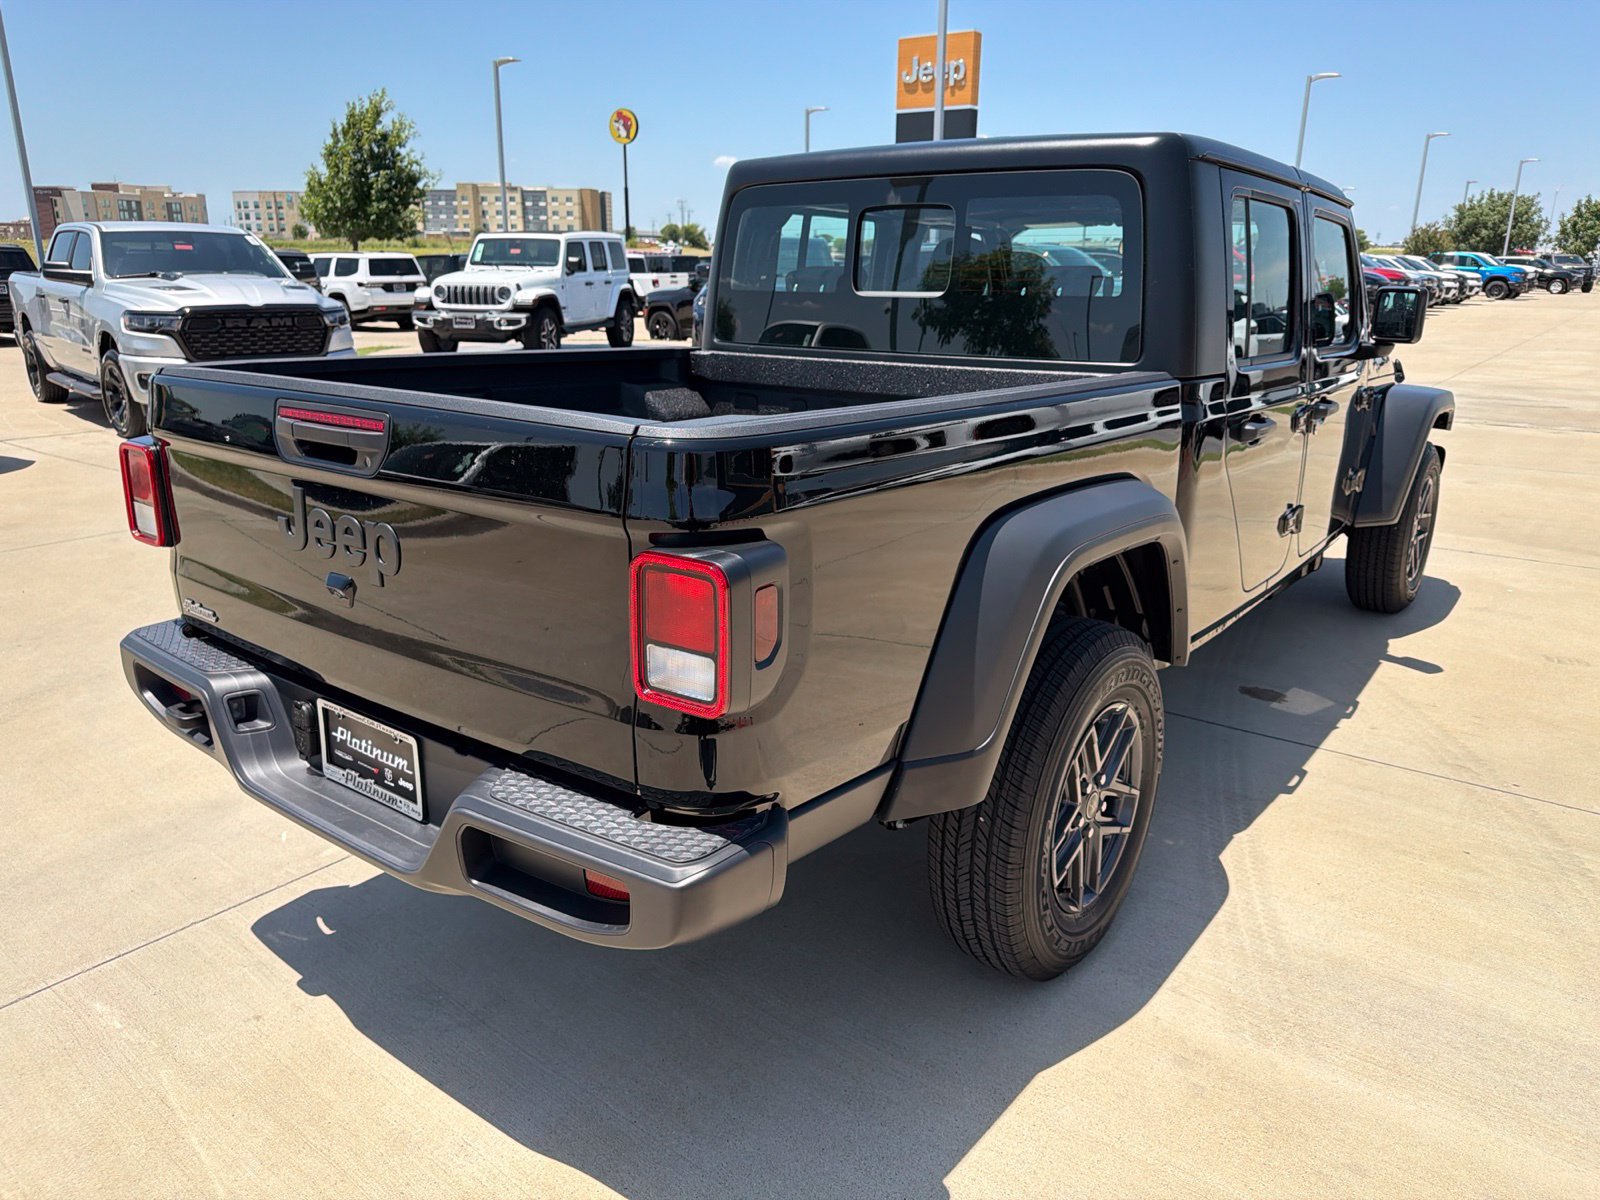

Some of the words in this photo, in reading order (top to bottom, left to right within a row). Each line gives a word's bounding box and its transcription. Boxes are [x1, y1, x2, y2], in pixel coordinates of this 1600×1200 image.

[225, 317, 293, 327] RAM
[277, 486, 402, 588] Jeep
[331, 726, 413, 775] Platinum
[345, 771, 401, 807] Platinum
[398, 777, 413, 791] Jeep
